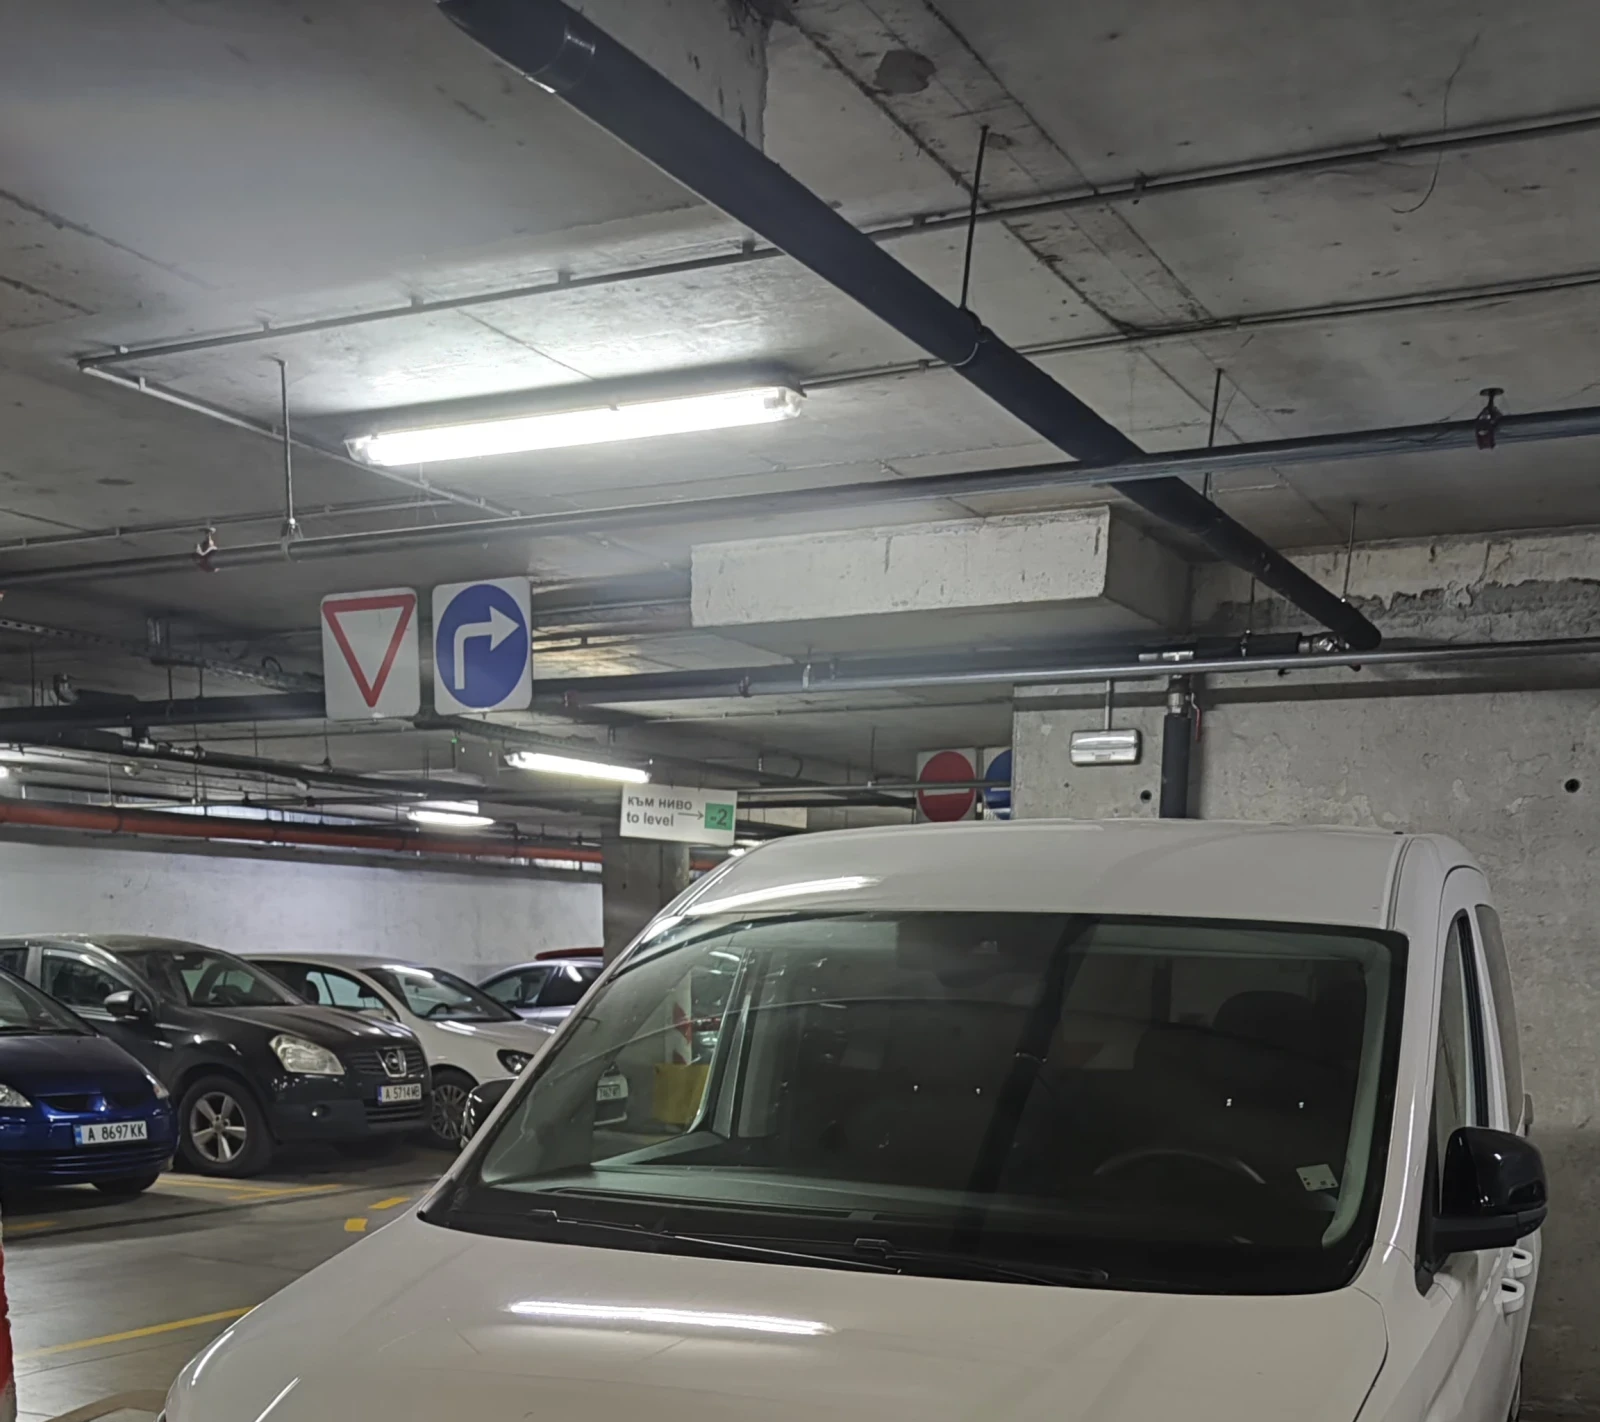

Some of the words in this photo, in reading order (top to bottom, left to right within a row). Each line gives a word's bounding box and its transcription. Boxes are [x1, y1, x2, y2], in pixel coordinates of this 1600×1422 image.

[627, 812, 639, 824] to
[643, 812, 674, 827] level
[710, 808, 728, 827] -2
